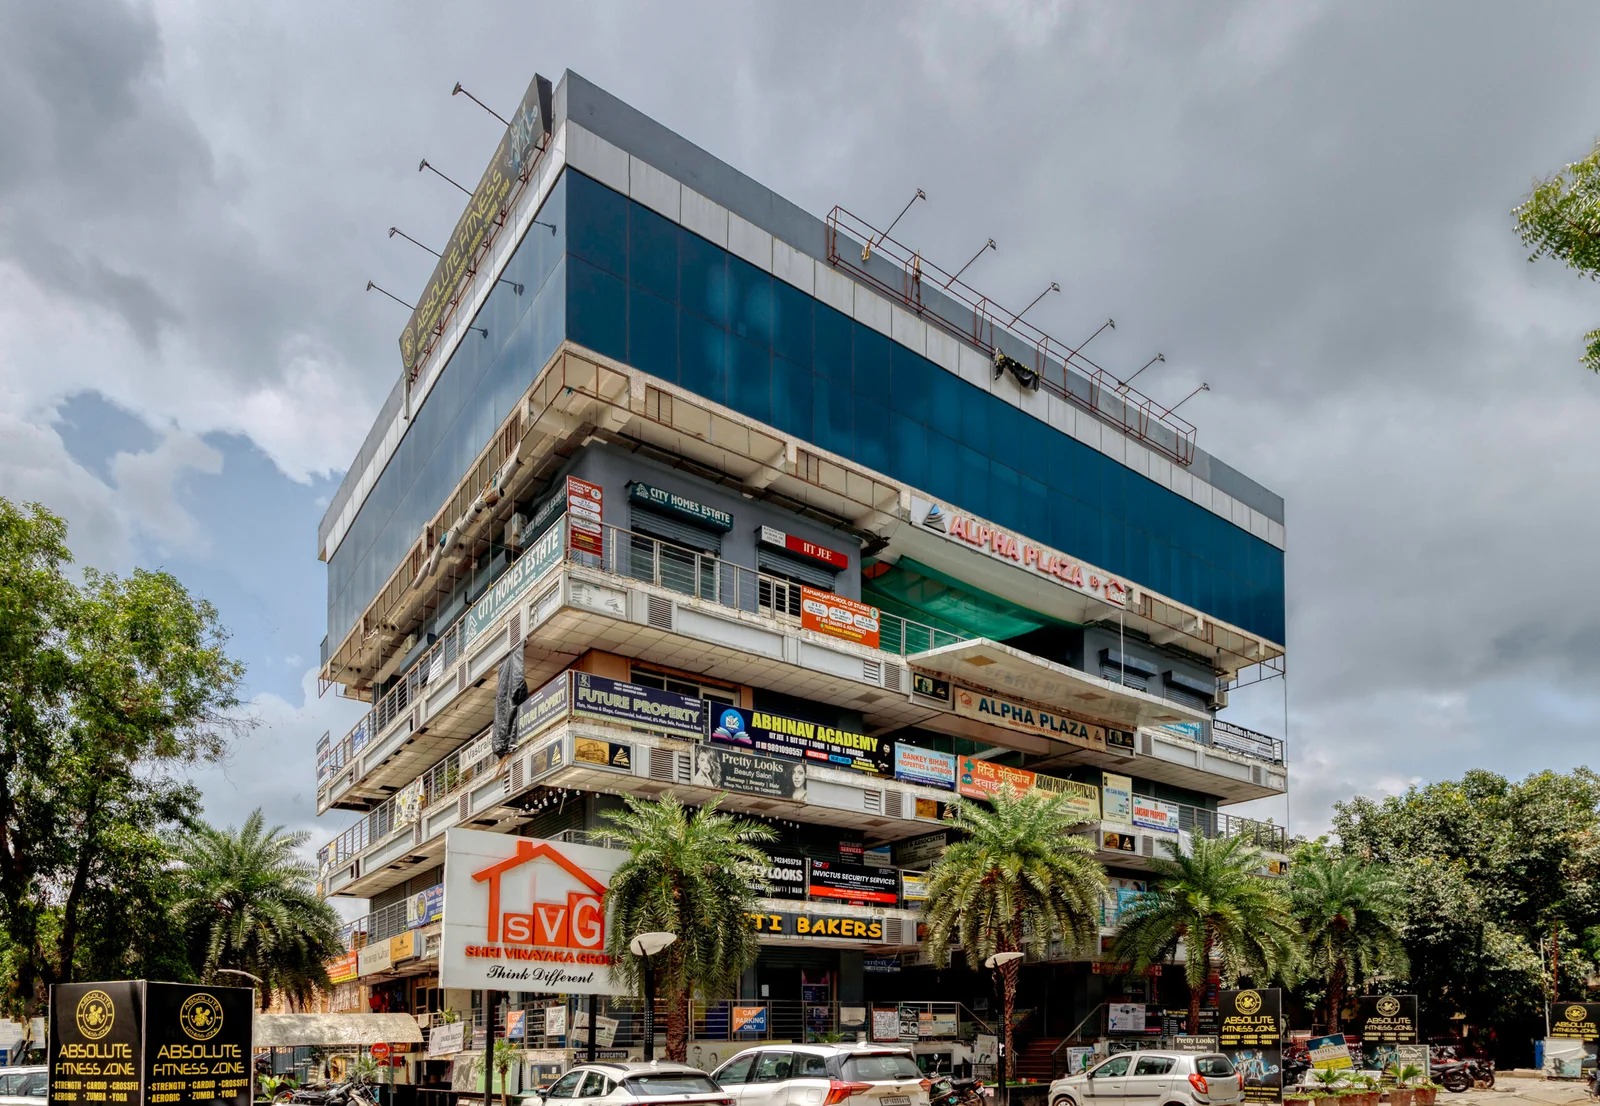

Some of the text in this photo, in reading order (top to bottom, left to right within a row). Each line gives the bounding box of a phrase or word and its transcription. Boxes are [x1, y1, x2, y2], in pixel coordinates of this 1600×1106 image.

[417, 168, 503, 337] ABSOLUTE FITNESS
[650, 487, 669, 502] CITY
[671, 494, 700, 512] HOMES
[701, 505, 731, 523] ESTATE
[803, 542, 832, 560] IIT JEE
[948, 515, 1020, 562] ALPHA
[1024, 544, 1084, 588] PLAZA
[477, 590, 495, 620] CITY
[495, 562, 524, 607] HOMES
[525, 526, 559, 575] ESTATE
[578, 686, 630, 710] FUTURE
[633, 698, 700, 723] PROPERTY
[978, 697, 1090, 741] ALPHA PLAZA
[751, 711, 879, 752] ABHINAV ACADEMY
[722, 752, 784, 773] Pretty Looks
[898, 759, 925, 770] PROPERTIES
[902, 751, 949, 767] BANKEY BIHARI
[733, 767, 773, 780] Beauty Salon
[767, 867, 803, 882] LOOKS
[812, 869, 896, 886] INVICTUS SECURITY SERVICES
[797, 917, 882, 938] BAKERS
[465, 944, 575, 965] SHRI VINAYAKA
[486, 964, 595, 987] Think Different
[80, 992, 112, 1010] ABSOLUTE
[184, 994, 220, 1012] ABSOLUTE
[1223, 1015, 1275, 1024] ABSOLUTE
[1554, 1021, 1597, 1029] ABSOLUTE
[1221, 1024, 1277, 1032] FITNESS ZONE
[58, 1043, 132, 1058] ABSOLUTE
[157, 1044, 242, 1059] ABSOLUTE
[55, 1062, 135, 1075] FITNESS ZONE
[152, 1061, 245, 1076] FITNESS ZONE
[54, 1080, 139, 1090] STRENGTH CARDIO CROSSFIT
[151, 1078, 249, 1091] STRENGTH CARDIO CROSSFIT
[54, 1092, 128, 1102] AEROBIC ZUMBA YOGA
[151, 1089, 238, 1103] AEROBIC ZUMBA YOGA
